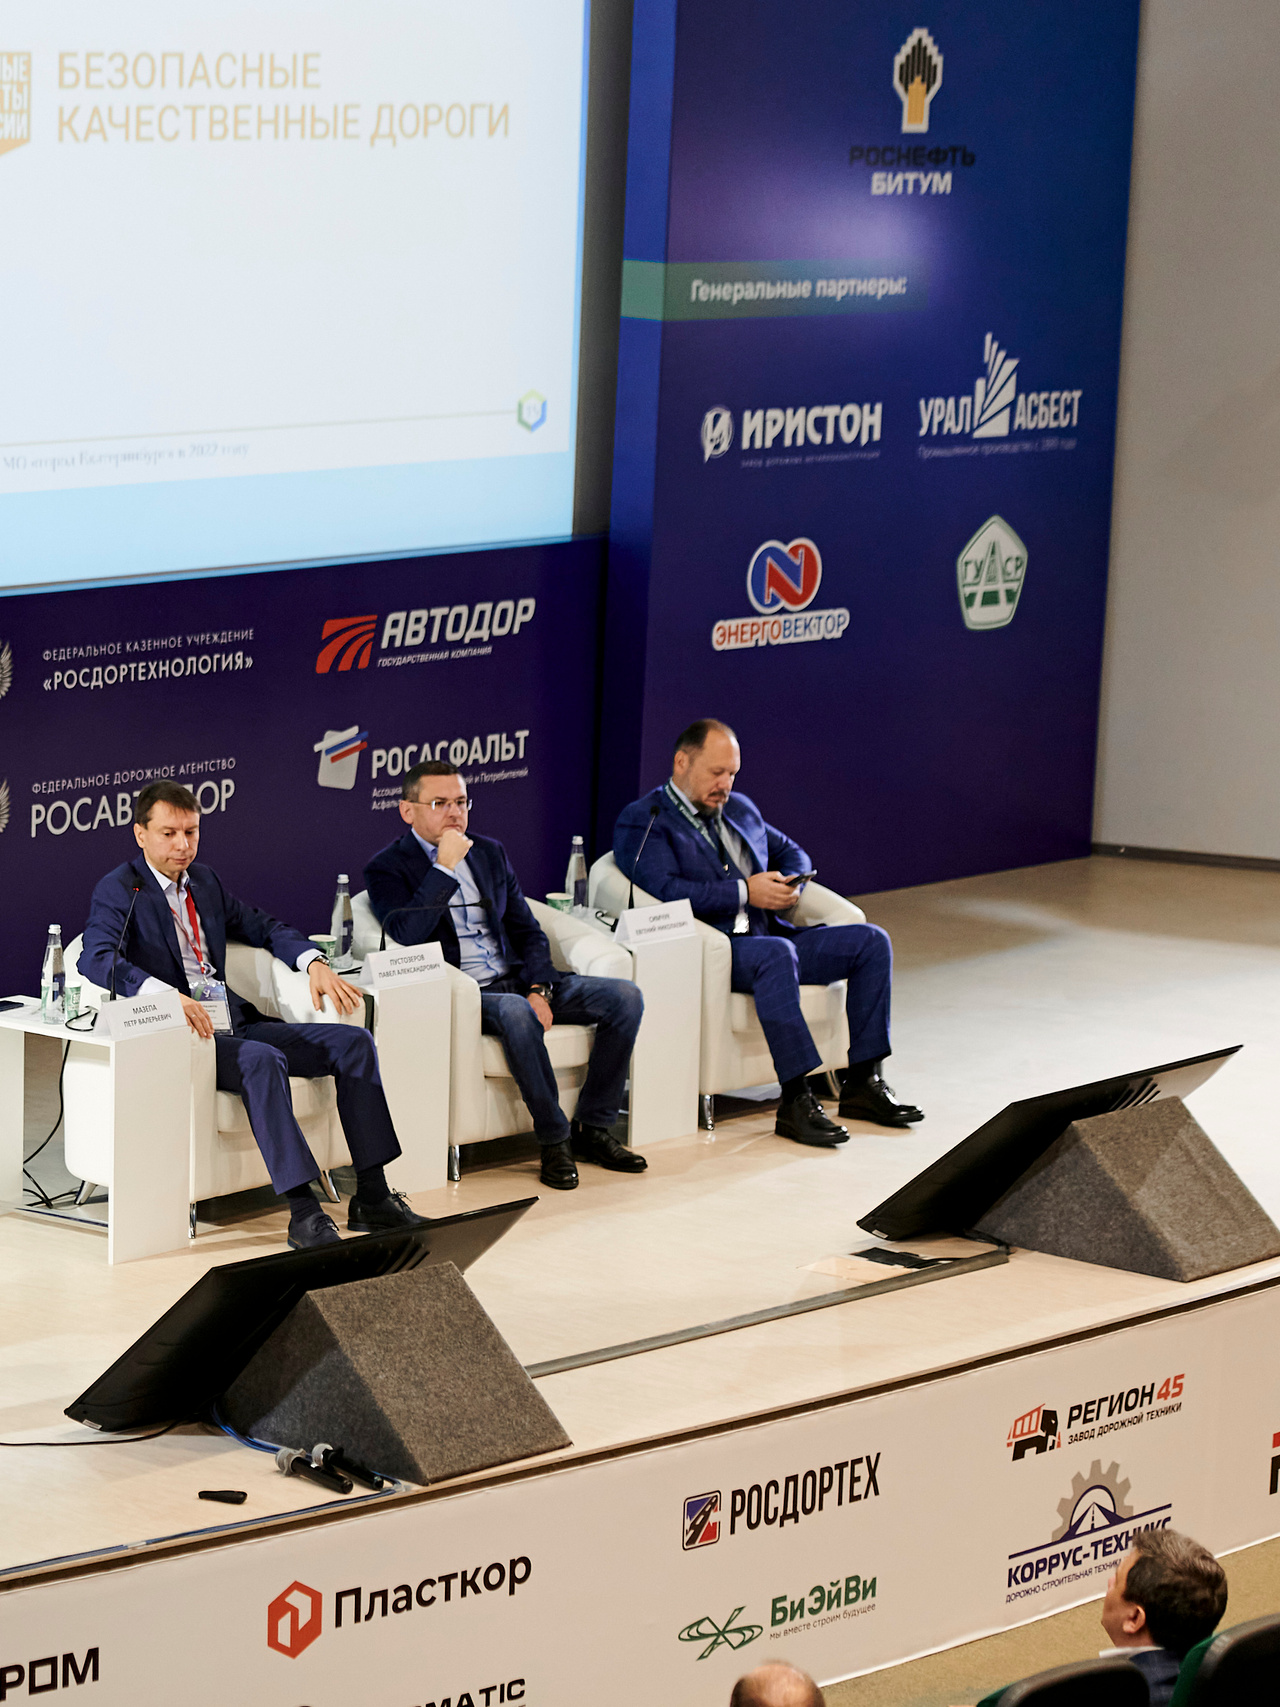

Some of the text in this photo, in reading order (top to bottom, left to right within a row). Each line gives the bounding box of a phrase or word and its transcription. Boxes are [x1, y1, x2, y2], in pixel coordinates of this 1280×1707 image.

[58, 51, 321, 90] БЕЗОПАСНЫЕ
[58, 102, 511, 148] КАЧЕСТВЕННЫЕ ДОРОГИ
[848, 145, 975, 168] РОСНЕФТЬ
[871, 171, 953, 196] БИТУМ
[690, 276, 907, 306] Генеральные партнеры:
[741, 402, 882, 450] ИРИСТОН
[919, 389, 1083, 437] УРАЛ АСБЕСТ
[381, 598, 536, 649] АВТОДОР
[715, 613, 847, 646] ЭНЕРГОВЕКТОР
[43, 628, 254, 662] ФЕДЕРАЛЬНОЕ КАЗЕННОЕ УЧРЕЖДЕНИЕ
[378, 646, 492, 667] ГОСУДАРСТВЕННАЯ КОМПАНИЯ
[43, 651, 253, 691] «РОСДОРТЕХНОЛОГИЯ»
[32, 757, 236, 794] ФЕДЕРАЛЬНОЕ ДОРОЖНОЕ АГЕНТСТВО
[31, 779, 235, 838] РОСАВОР
[378, 963, 440, 978] ПАВЕЛ АЛЕКСАНДРОВИЧ
[390, 954, 425, 966] ПУСТОЗЕРОВ
[124, 1013, 172, 1028] ПЕТР ВАЛЕРЬЕВИЧ
[132, 1004, 158, 1015] МАЗЕПА
[1067, 1373, 1185, 1429] РЕГИОН 45
[1068, 1402, 1182, 1445] ЗАВОД ДОРОЖНОЙ ТЕХНИКИ
[730, 1452, 881, 1535] РОСДОРТЕХ
[335, 1556, 532, 1628] Пласткор
[1005, 1558, 1121, 1604] ДОРОЖНО СТРОИТЕЛЬНАЯ ТЕХНИК
[769, 1603, 876, 1640] мы вместе строим будущее
